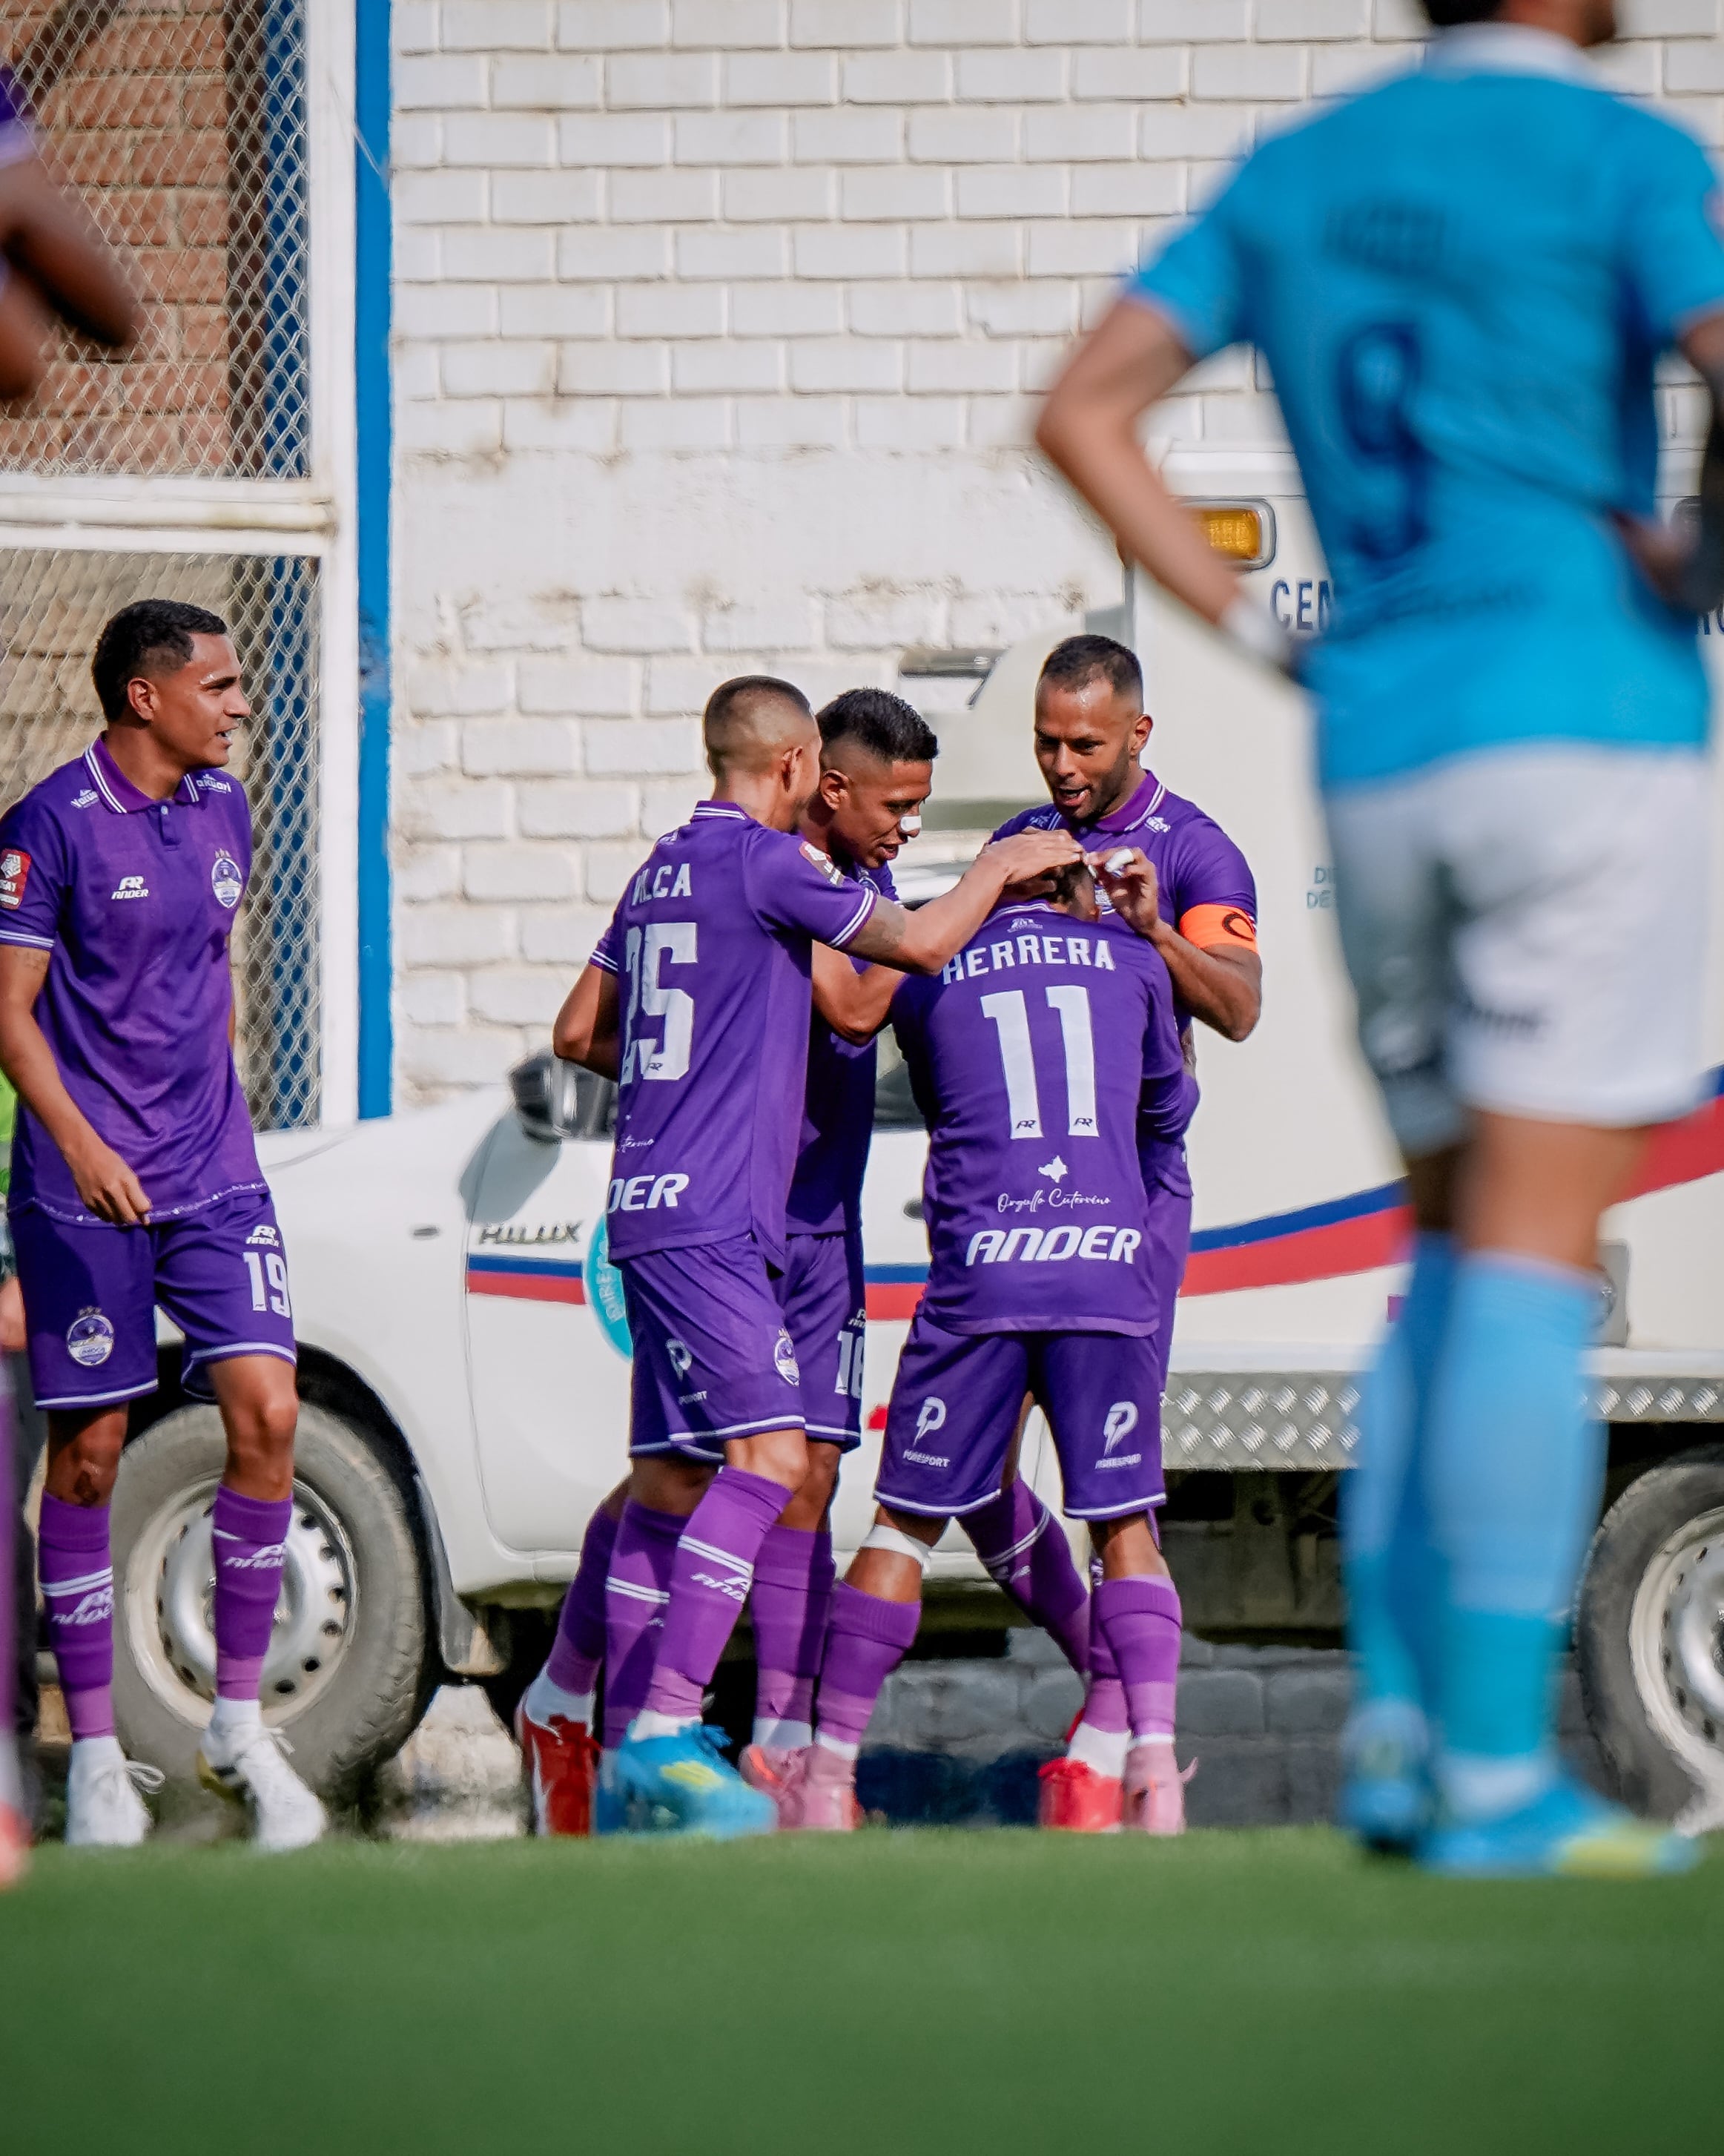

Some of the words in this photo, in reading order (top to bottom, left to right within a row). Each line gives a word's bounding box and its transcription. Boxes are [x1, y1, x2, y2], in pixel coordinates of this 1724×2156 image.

[942, 934, 1116, 985] HERRERA
[980, 985, 1100, 1140] 11
[479, 1220, 582, 1245] HILUX
[965, 1225, 1142, 1267] ANDER
[242, 1252, 291, 1319] 19
